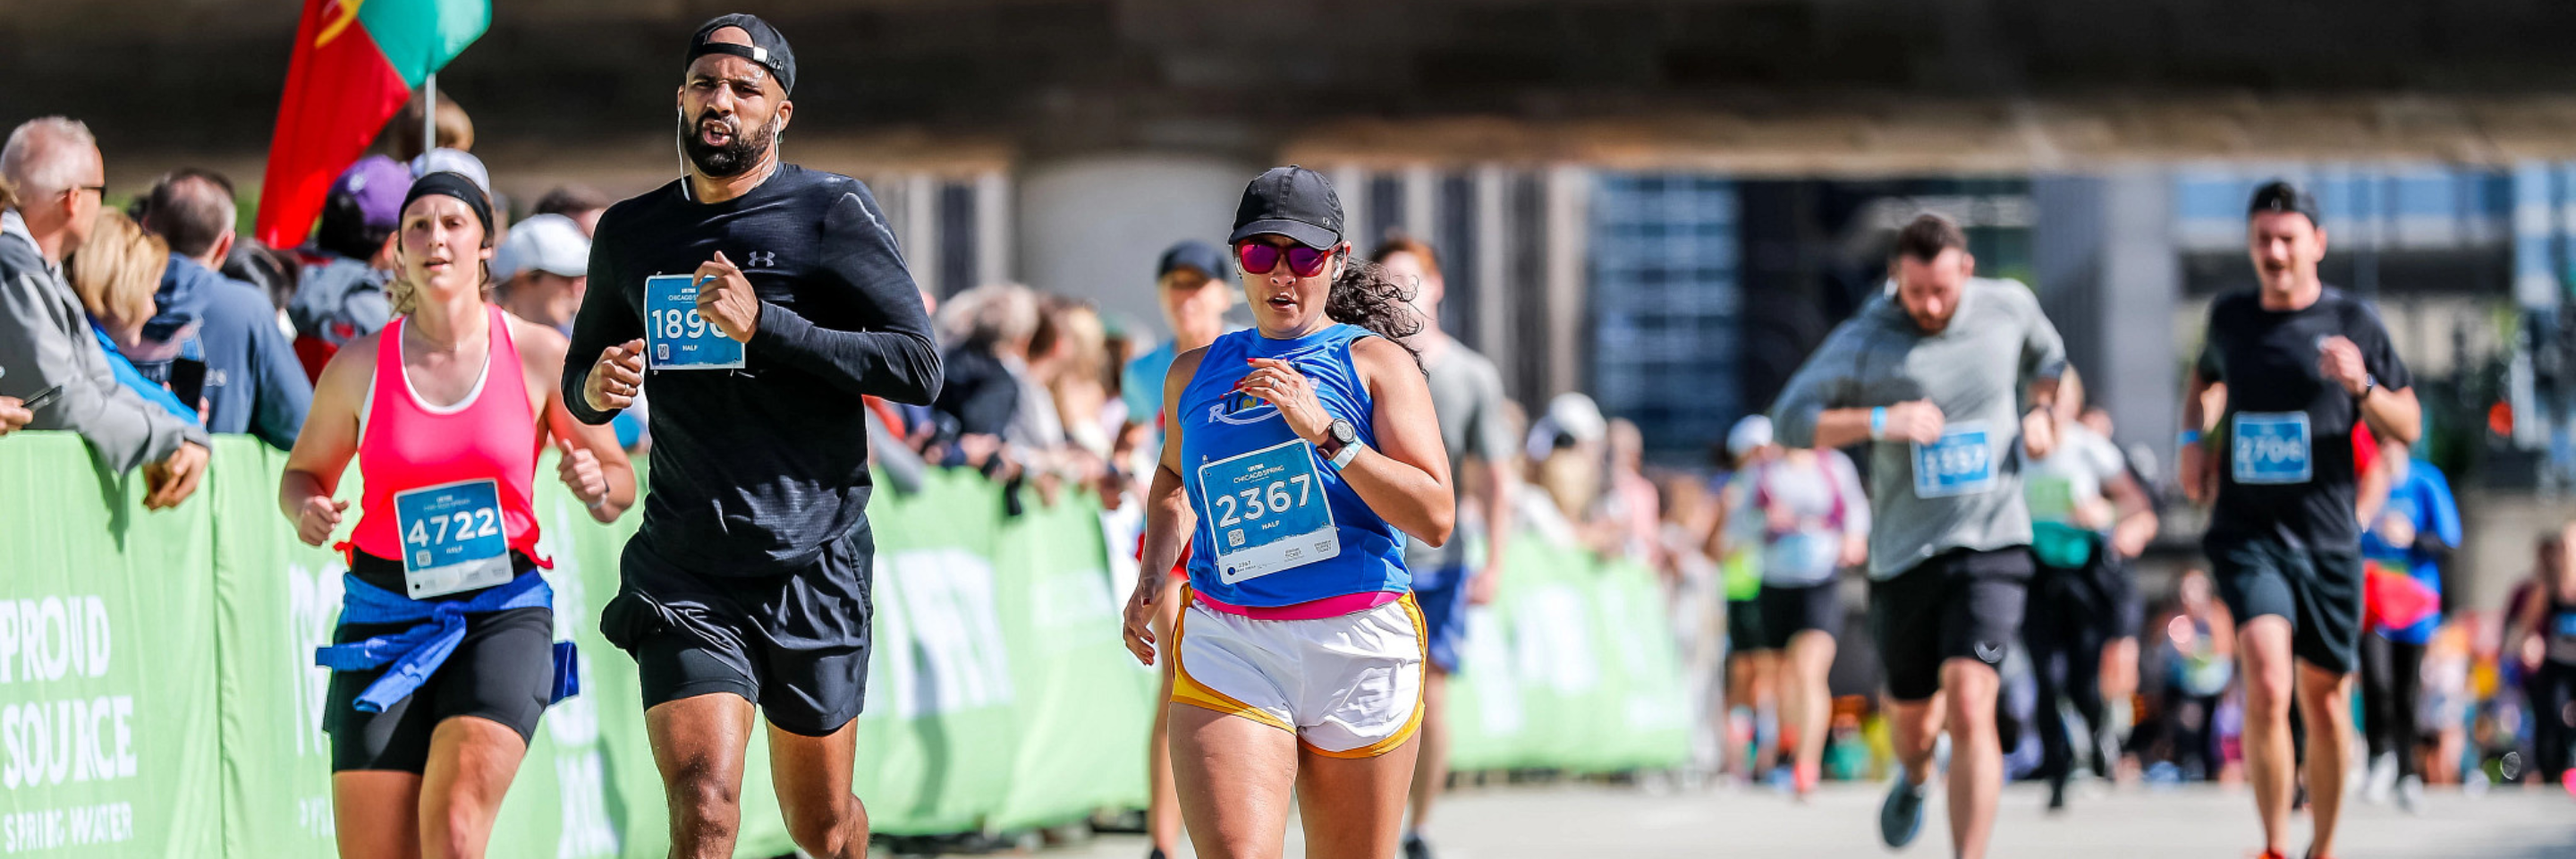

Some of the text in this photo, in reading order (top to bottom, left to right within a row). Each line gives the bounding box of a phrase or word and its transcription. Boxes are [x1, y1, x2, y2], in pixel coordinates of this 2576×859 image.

[407, 507, 498, 548] 4722
[1216, 473, 1310, 528] 2367
[1261, 520, 1280, 530] HALF
[0, 594, 111, 684] PROUD
[3, 694, 137, 790] SOURCE
